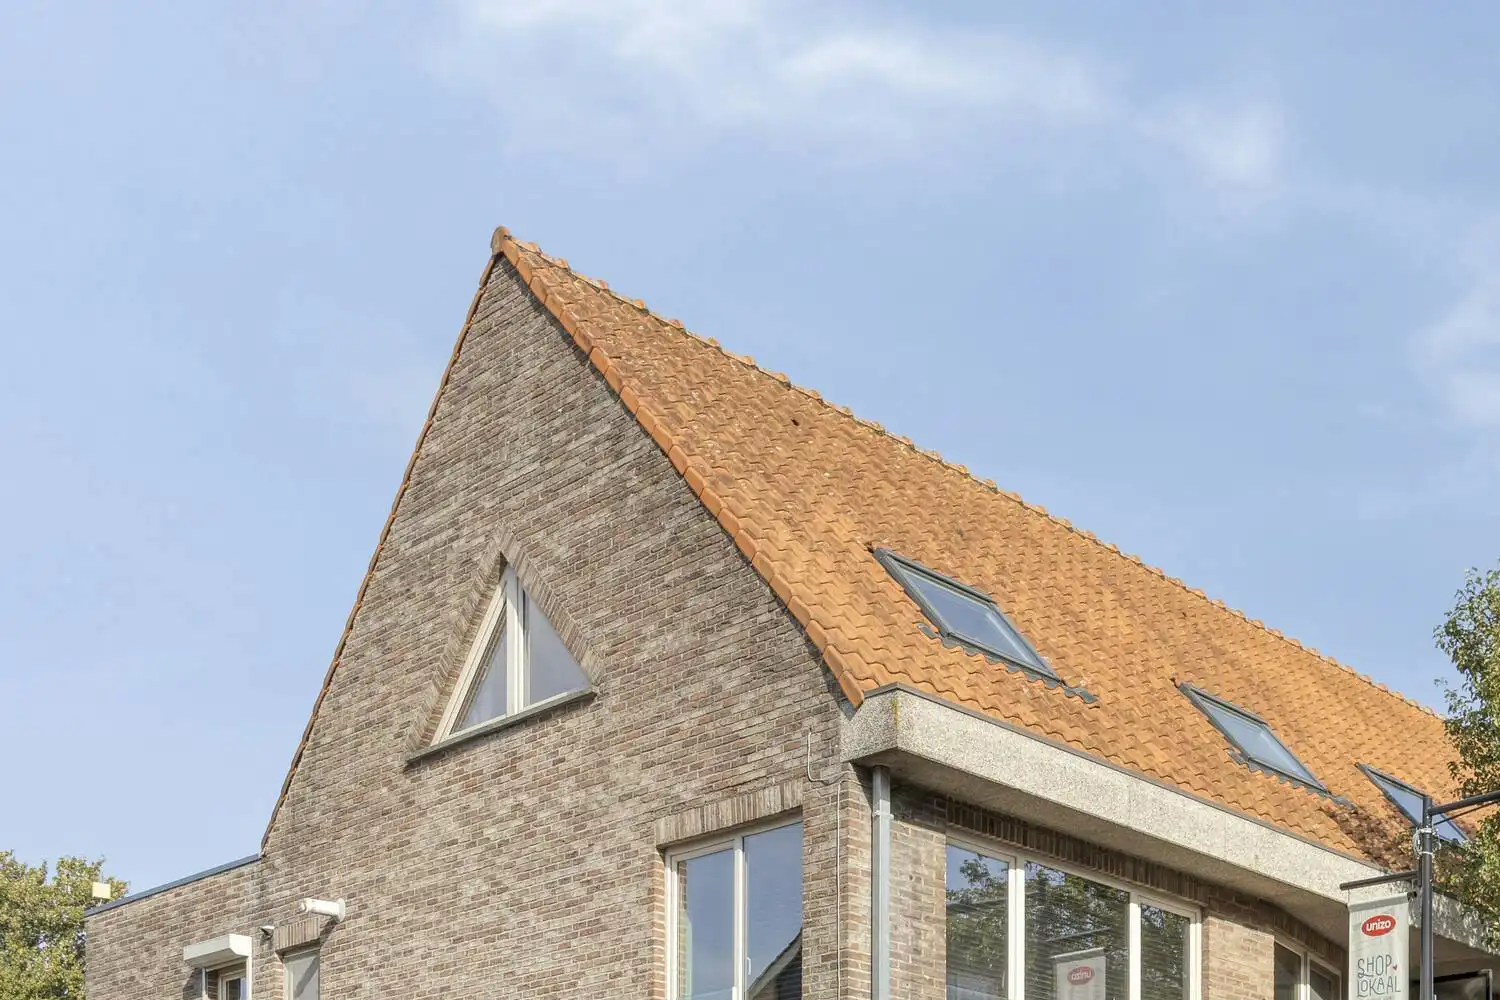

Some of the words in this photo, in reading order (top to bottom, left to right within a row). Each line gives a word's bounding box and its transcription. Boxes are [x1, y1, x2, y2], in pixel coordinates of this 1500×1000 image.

[1366, 918, 1391, 932] unizo
[1357, 954, 1392, 979] SHOP
[1357, 976, 1401, 998] LOKAAL
